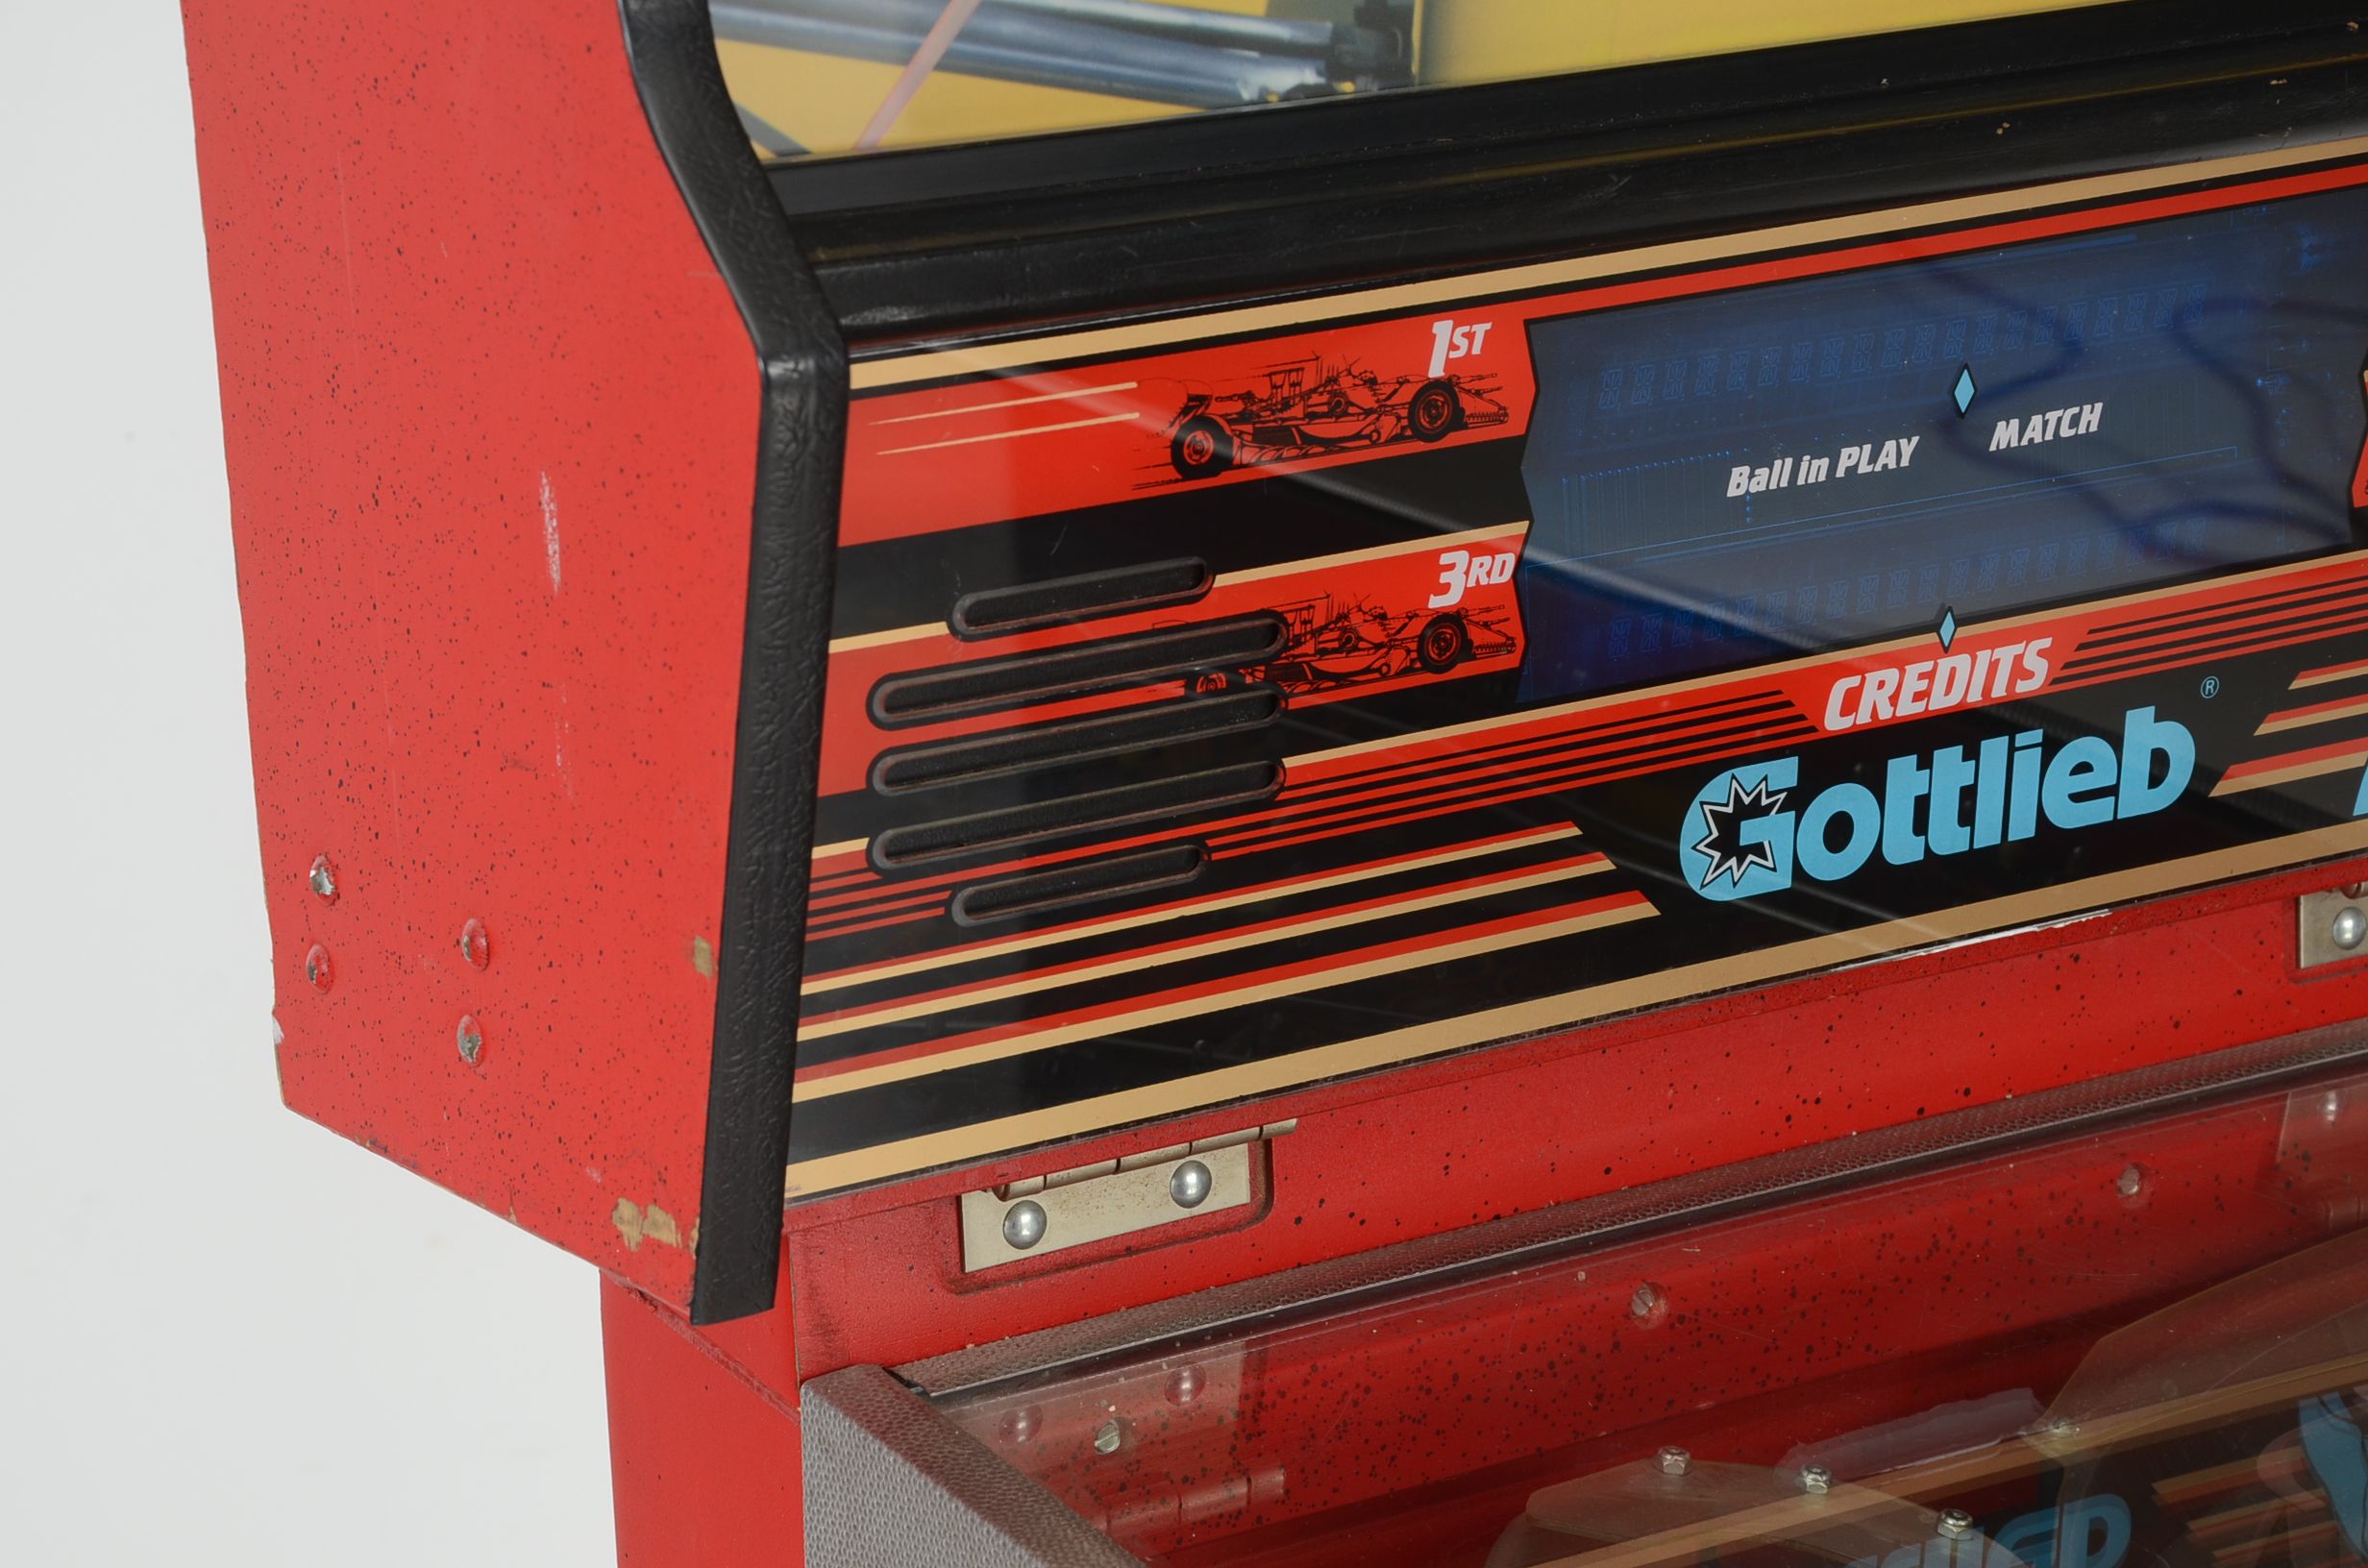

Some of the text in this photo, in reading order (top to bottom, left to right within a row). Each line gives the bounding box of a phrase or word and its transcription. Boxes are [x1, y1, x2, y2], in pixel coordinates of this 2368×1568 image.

[1428, 319, 1492, 378] 1ST
[1988, 402, 2104, 452] MATCH
[1726, 435, 1920, 498] Ball in PLAY
[1428, 550, 1516, 608] 3RD
[1825, 637, 2052, 731] CREDITS
[1680, 705, 2196, 901] Gottlieb
